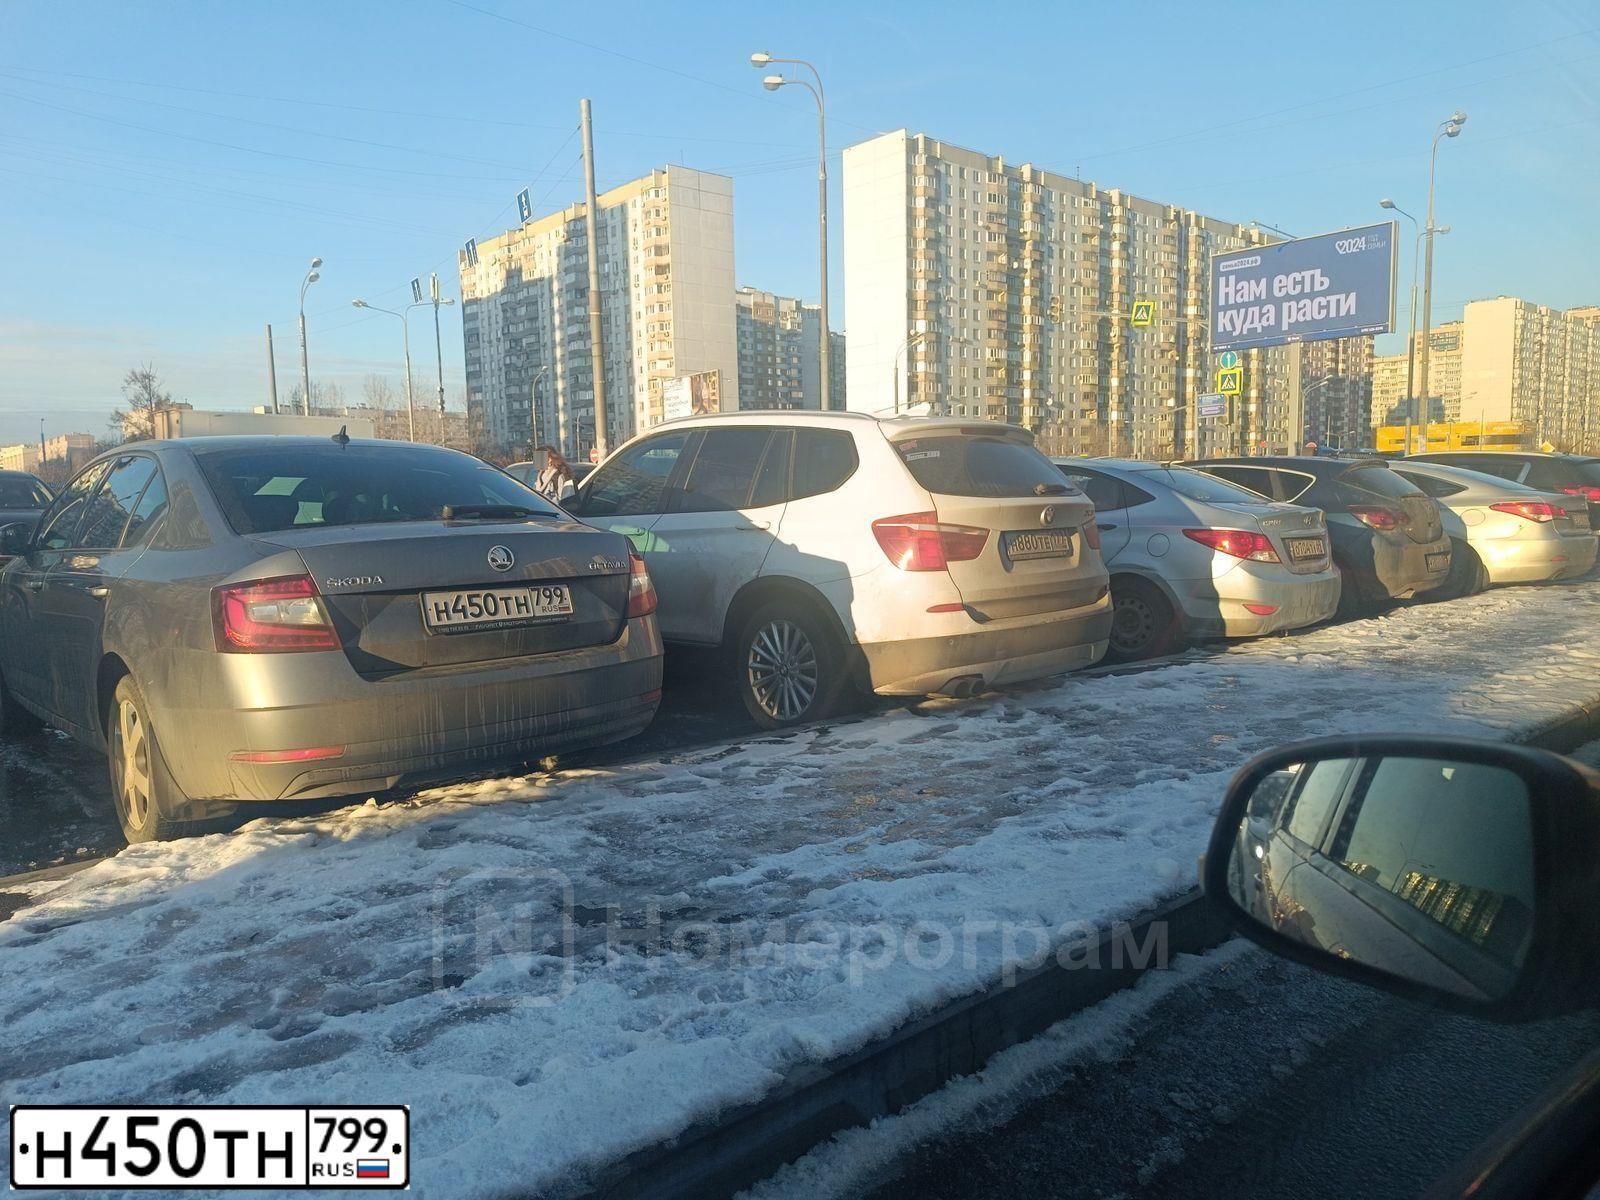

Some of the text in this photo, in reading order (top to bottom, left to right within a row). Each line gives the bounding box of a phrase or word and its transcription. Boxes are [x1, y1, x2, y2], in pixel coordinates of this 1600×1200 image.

[1218, 268, 1330, 306] Нам есть
[1217, 292, 1356, 336] куда расти
[433, 586, 564, 622] Н450ТН 799
[541, 605, 559, 613] RUS
